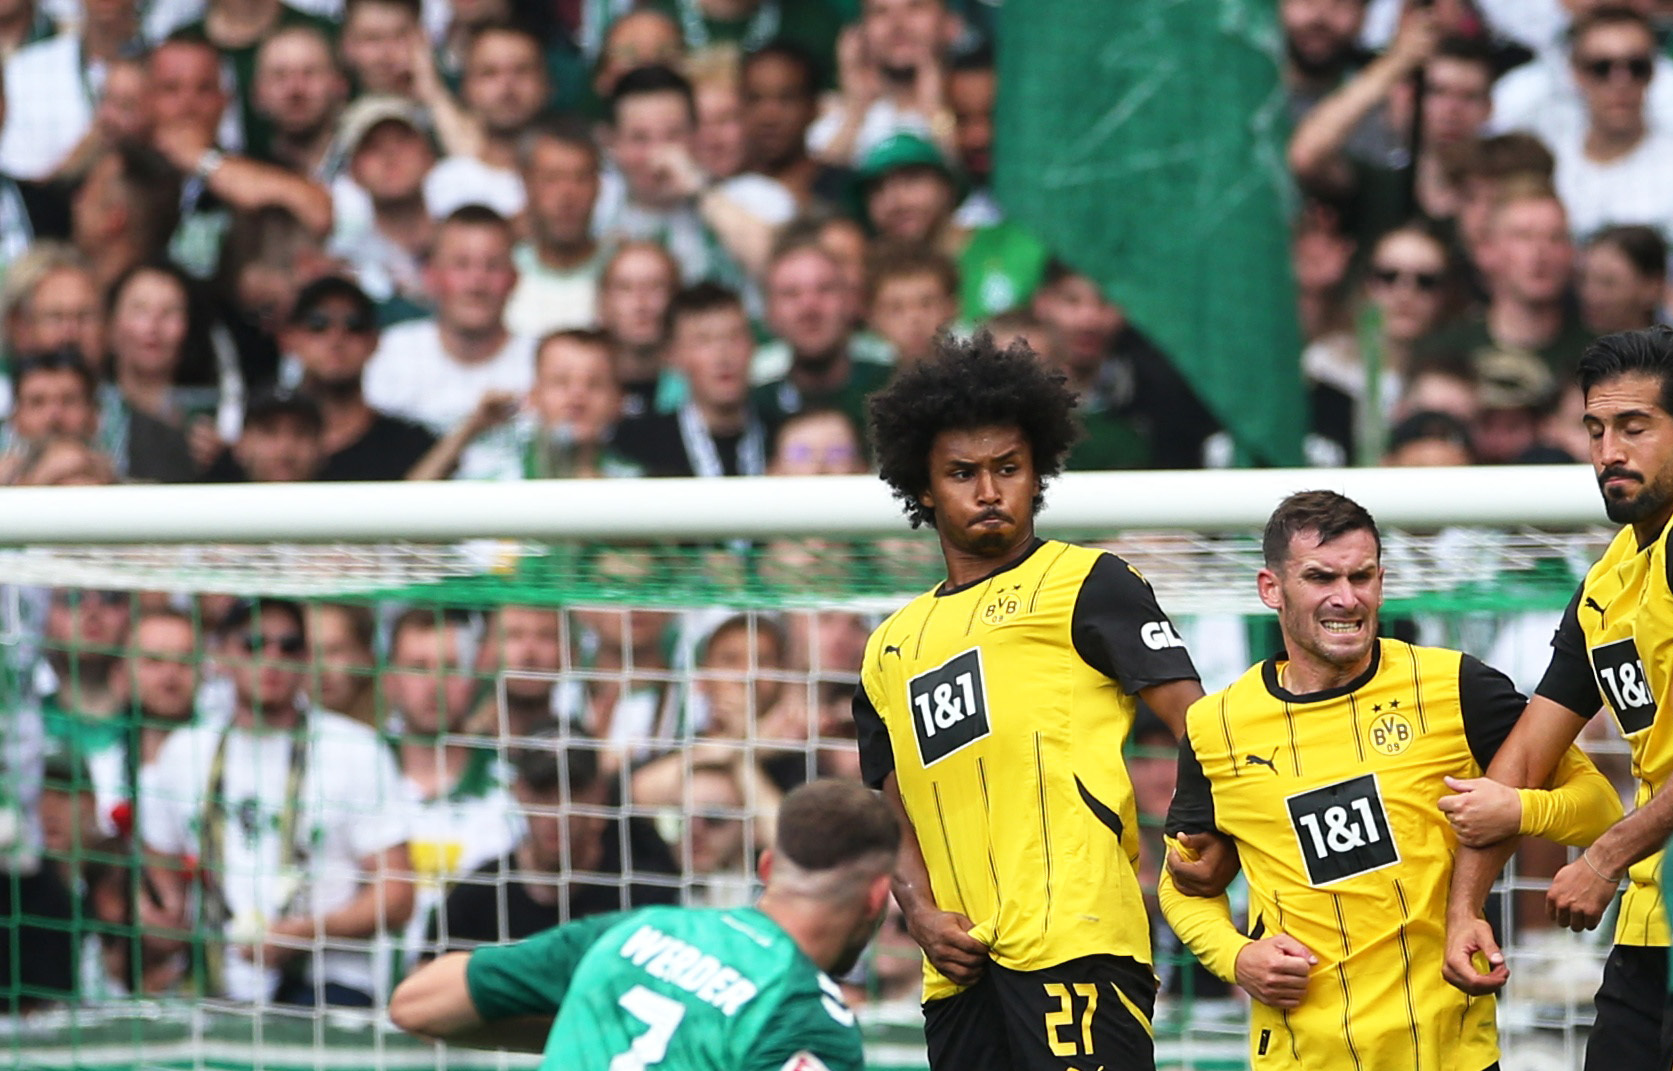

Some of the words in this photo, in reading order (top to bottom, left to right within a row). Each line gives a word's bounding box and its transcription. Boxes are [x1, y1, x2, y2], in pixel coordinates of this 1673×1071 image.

[986, 597, 1018, 618] BVB
[1140, 621, 1188, 651] GL
[915, 672, 977, 739] 1&1
[1373, 717, 1410, 745] BVB
[1299, 797, 1380, 859] 1&1
[620, 925, 758, 1017] WERDER
[1043, 983, 1099, 1057] 27
